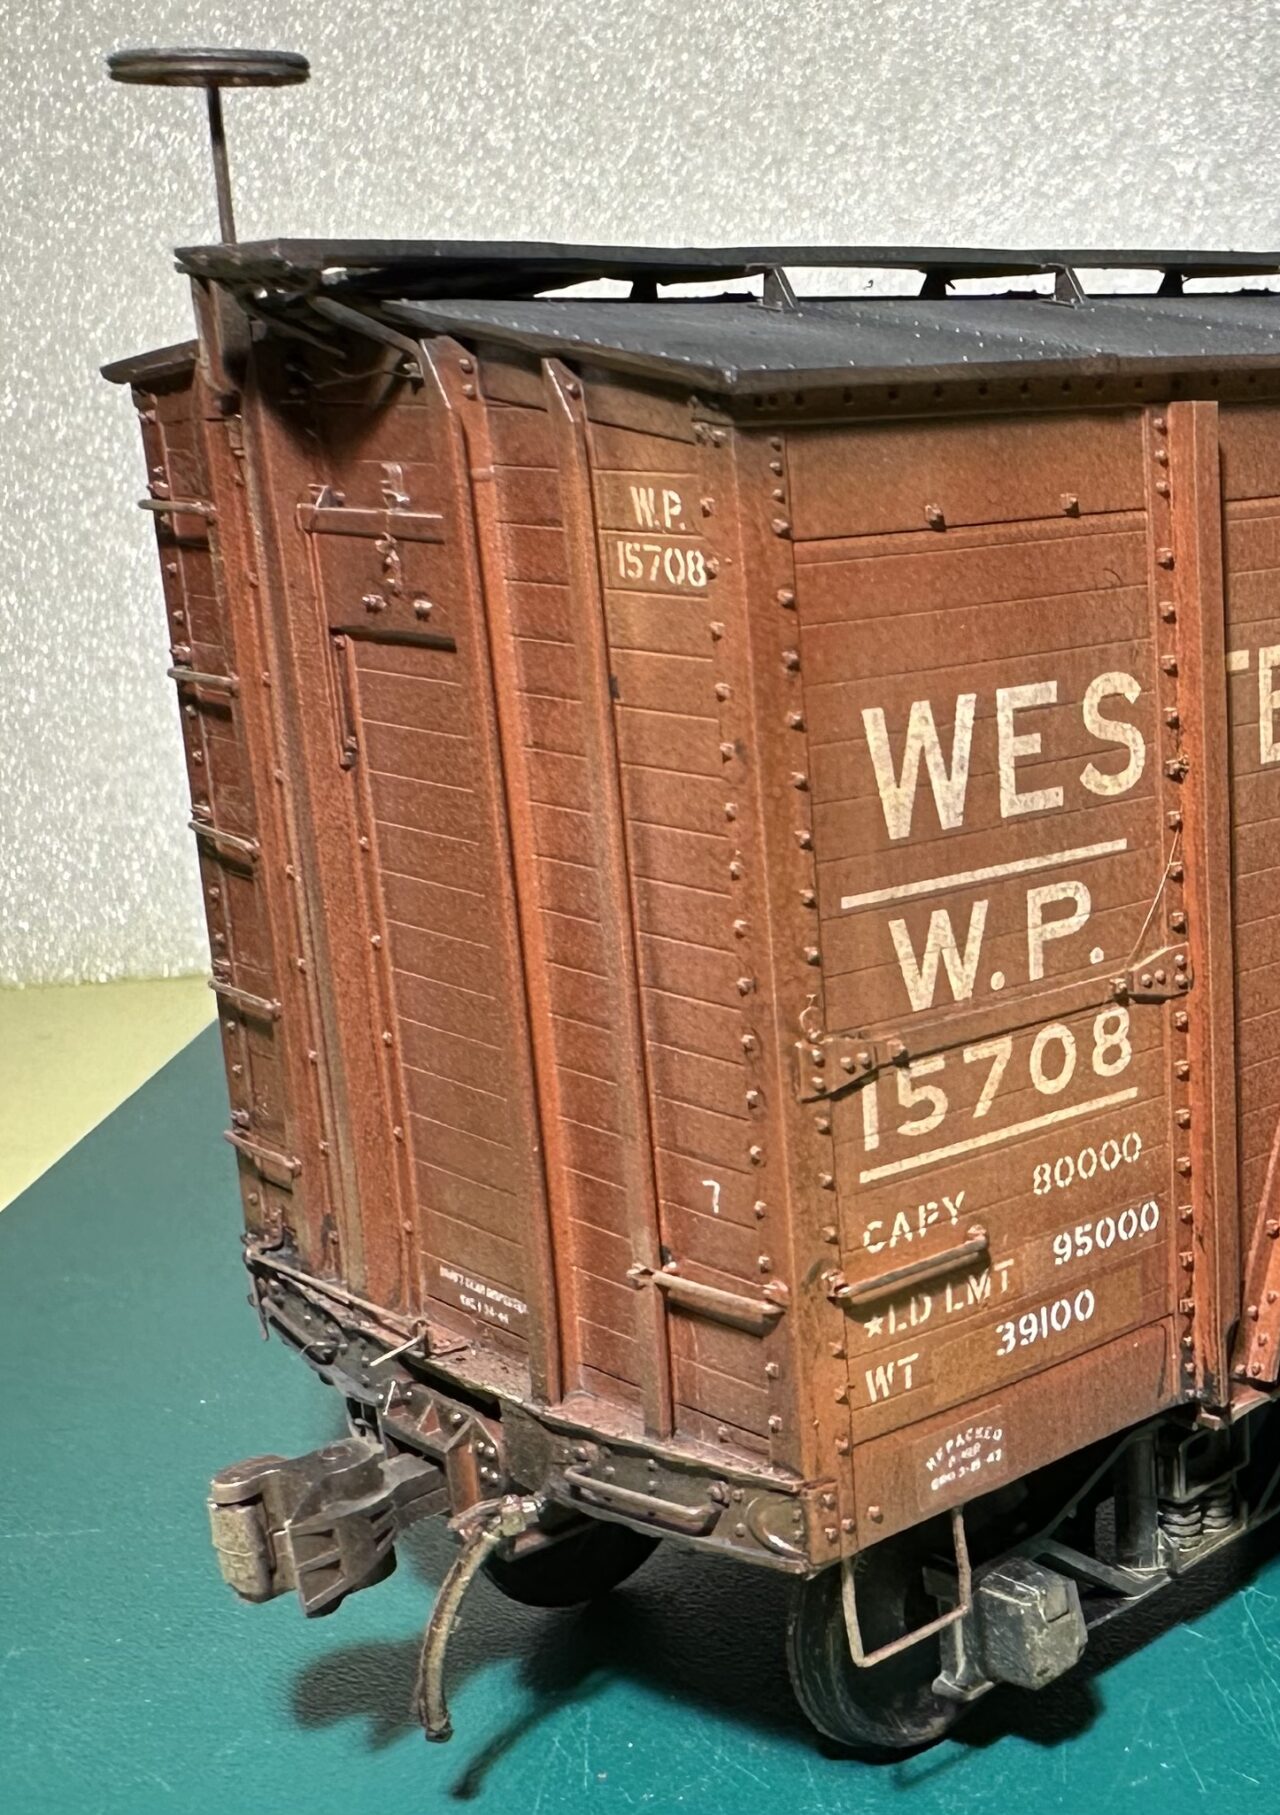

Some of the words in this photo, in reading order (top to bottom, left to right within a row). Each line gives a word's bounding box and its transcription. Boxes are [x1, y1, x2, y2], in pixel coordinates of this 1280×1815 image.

[630, 486, 686, 531] W.P.
[617, 541, 707, 587] 15708
[888, 880, 1104, 1012] W.P.
[861, 1006, 1133, 1151] 15708
[1033, 1132, 1142, 1195] 80000
[863, 1191, 965, 1254] CAPY
[945, 1258, 1015, 1313] LMT
[1053, 1200, 1160, 1266] 95000
[865, 1352, 919, 1402] WT
[995, 1288, 1095, 1356] 39100
